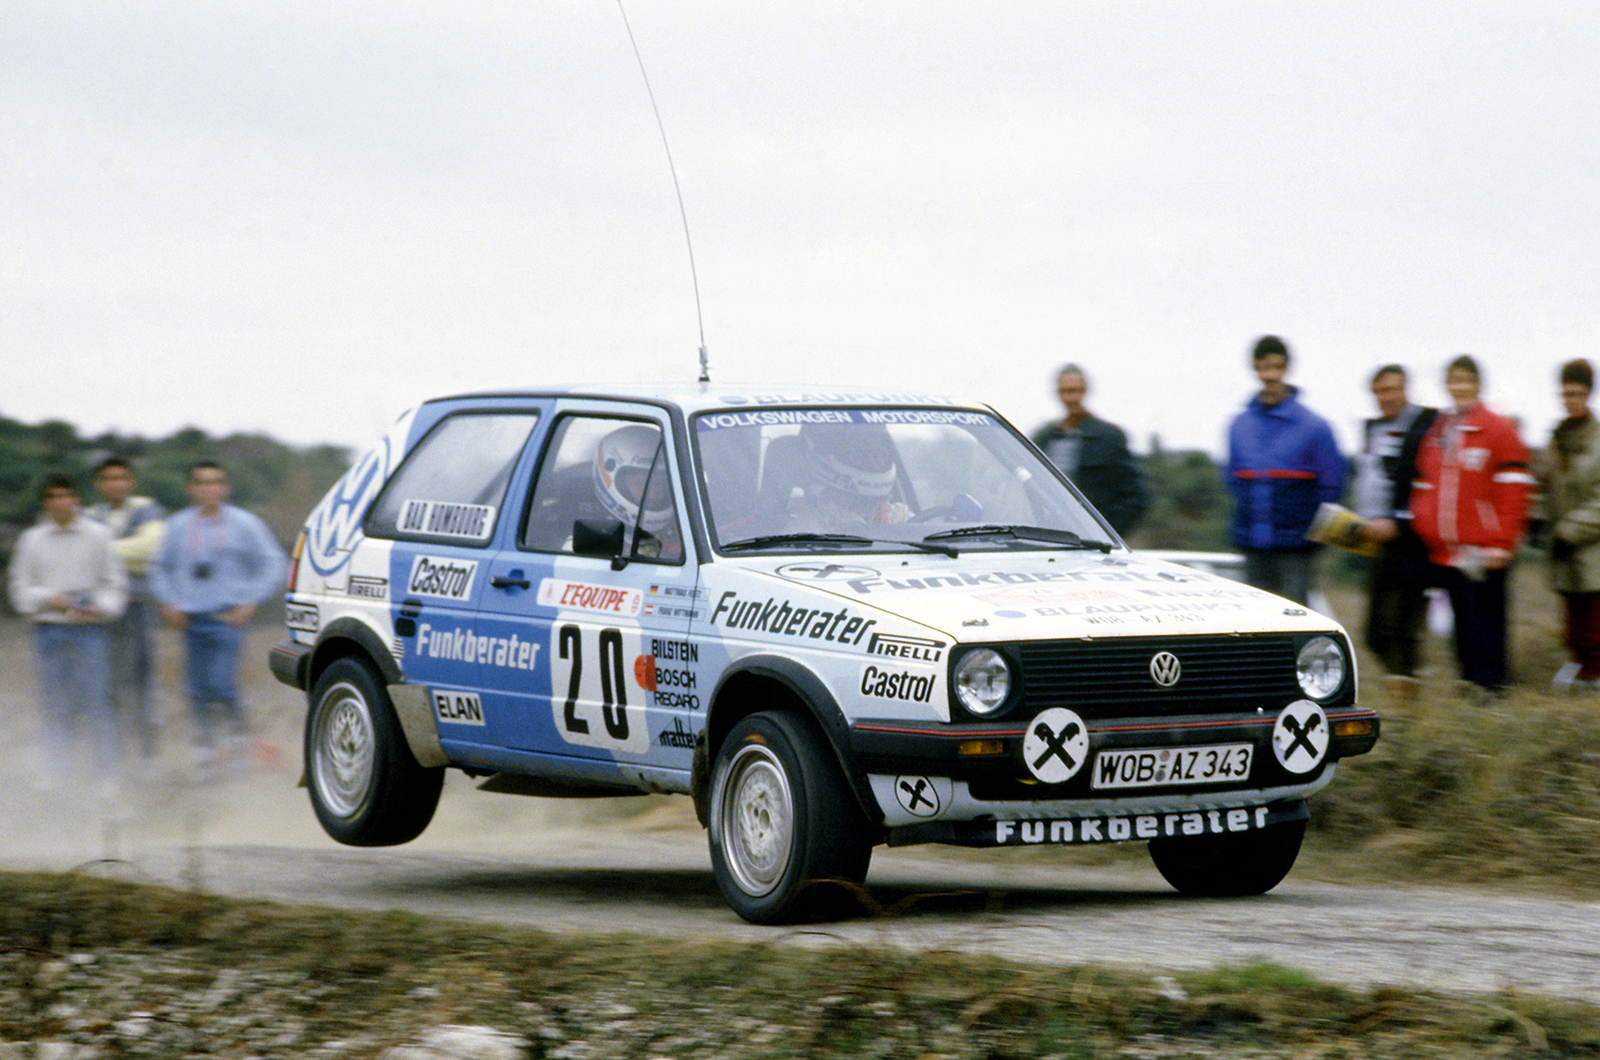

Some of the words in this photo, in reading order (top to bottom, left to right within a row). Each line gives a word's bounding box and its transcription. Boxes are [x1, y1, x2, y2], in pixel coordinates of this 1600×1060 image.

[702, 410, 853, 430] VOLKSWAGEN
[861, 410, 991, 427] MOTORSPORT
[411, 557, 475, 598] Castrol
[710, 590, 877, 646] Funkberater
[1031, 602, 1247, 618] BLAUPUNKT
[416, 623, 541, 671] Funkberater
[652, 639, 698, 663] BILSTEIN
[866, 632, 947, 663] PIRELLI
[559, 623, 630, 741] 20
[656, 668, 697, 689] BOSCH
[861, 665, 937, 703] Castrol
[435, 695, 482, 722] ELAN
[653, 691, 700, 710] RECARO
[996, 806, 1270, 844] Funkberater
